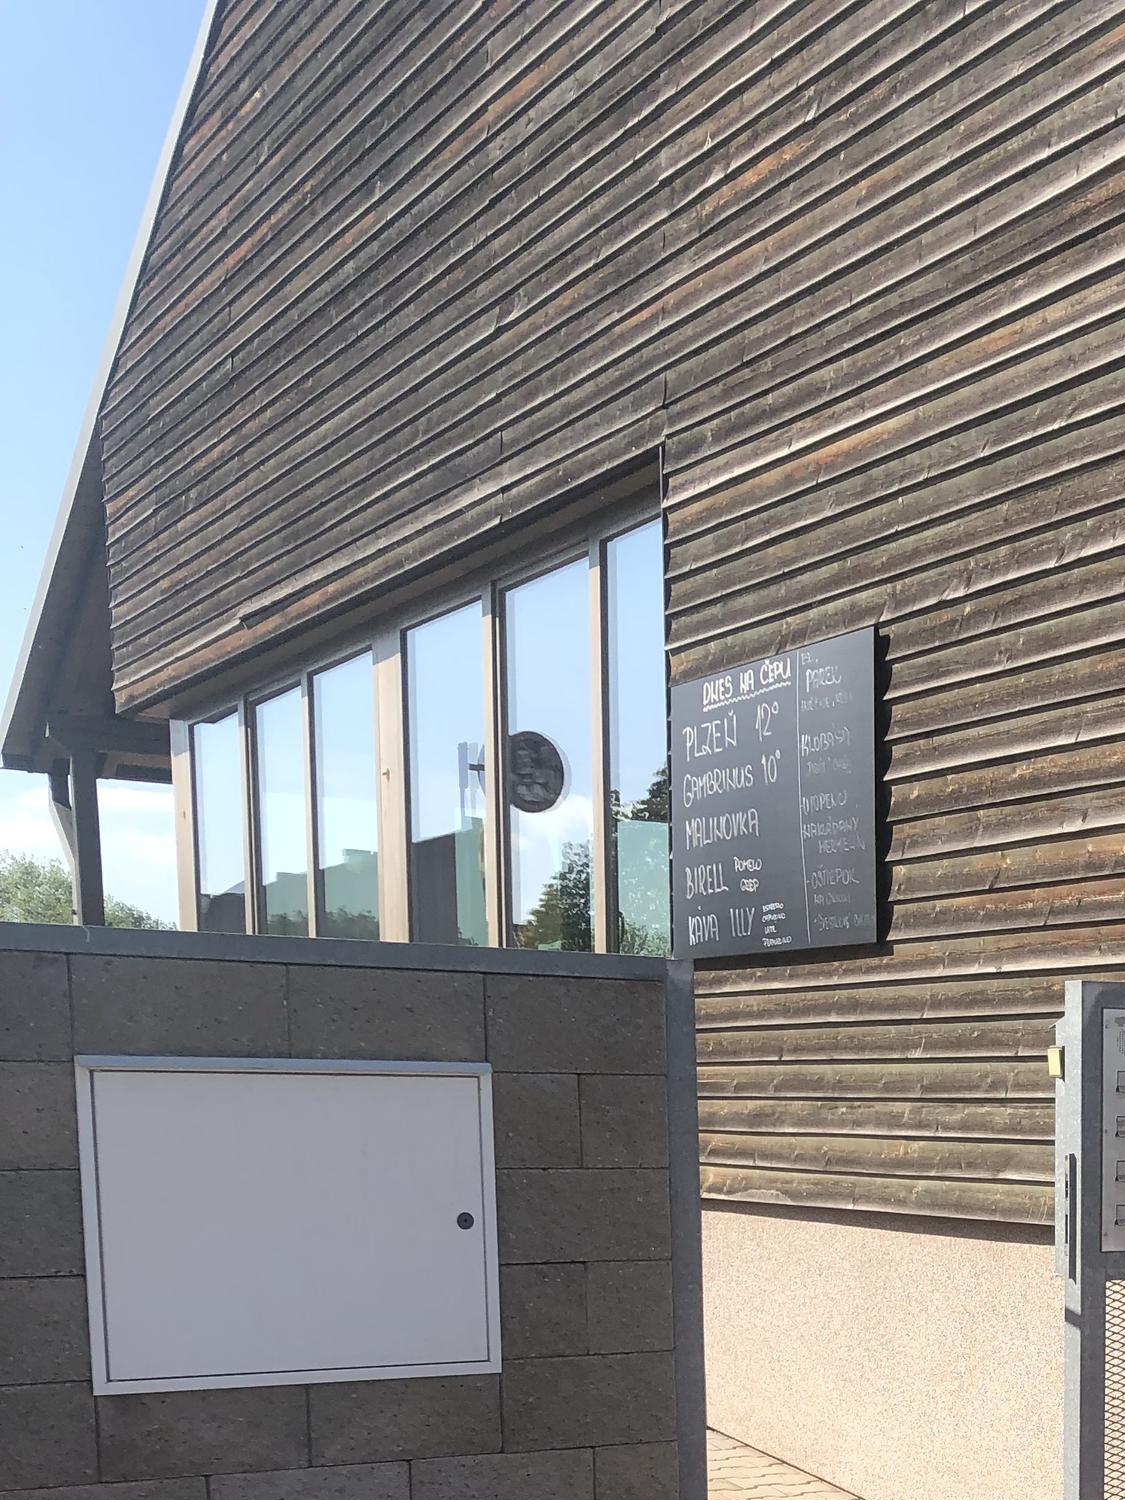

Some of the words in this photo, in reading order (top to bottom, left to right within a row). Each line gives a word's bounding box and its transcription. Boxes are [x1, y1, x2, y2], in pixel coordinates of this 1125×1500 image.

[702, 675, 733, 705] DNES
[739, 669, 755, 693] NA
[684, 764, 754, 808] GAMBRINUS
[685, 808, 760, 851] MALINOVKA
[685, 863, 729, 900] BIRELL
